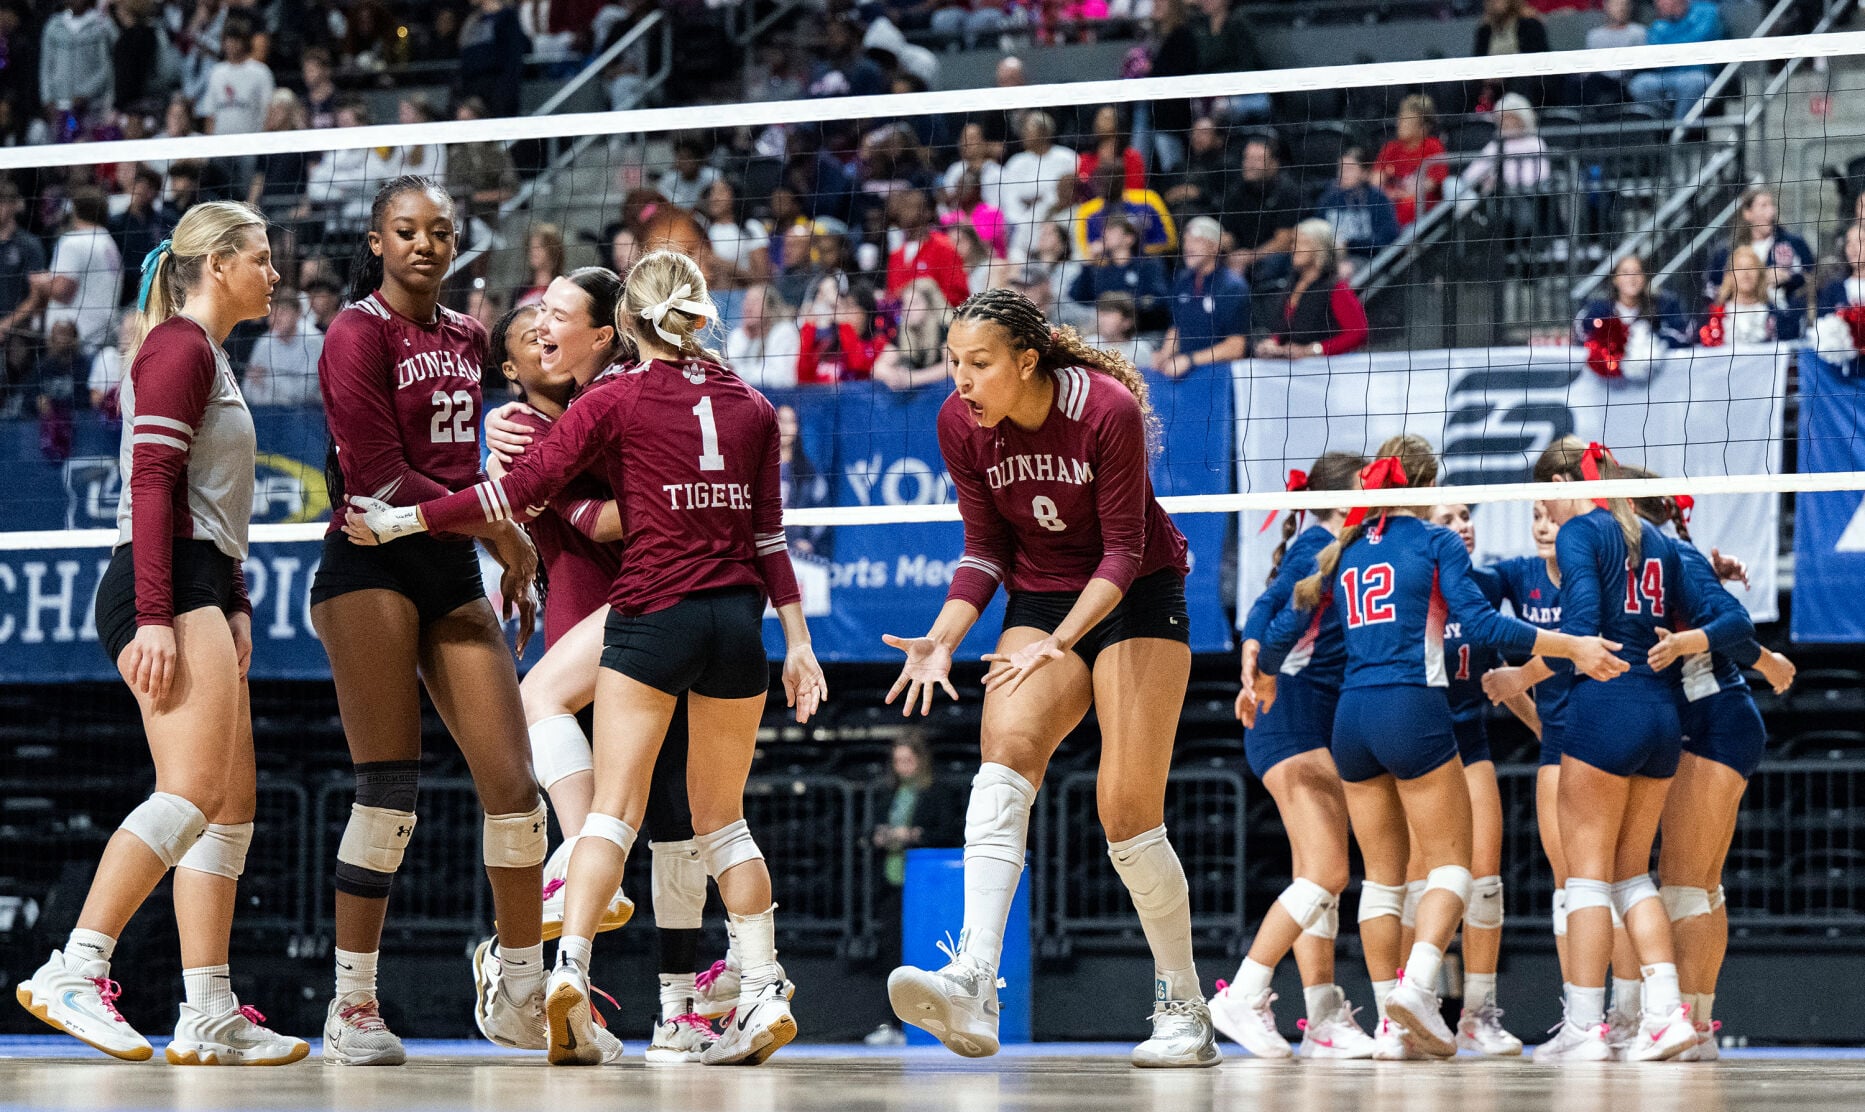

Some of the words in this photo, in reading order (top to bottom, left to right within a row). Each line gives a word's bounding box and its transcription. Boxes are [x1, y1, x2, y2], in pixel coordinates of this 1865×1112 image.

[431, 390, 476, 443] 22
[692, 396, 725, 471] 1
[986, 454, 1094, 489] DUNHAM
[662, 482, 752, 510] TIGERS
[1032, 495, 1067, 531] 8
[1340, 561, 1396, 629] 12
[1624, 556, 1665, 617] 14
[1522, 602, 1562, 623] LADY
[1455, 643, 1471, 681] 1
